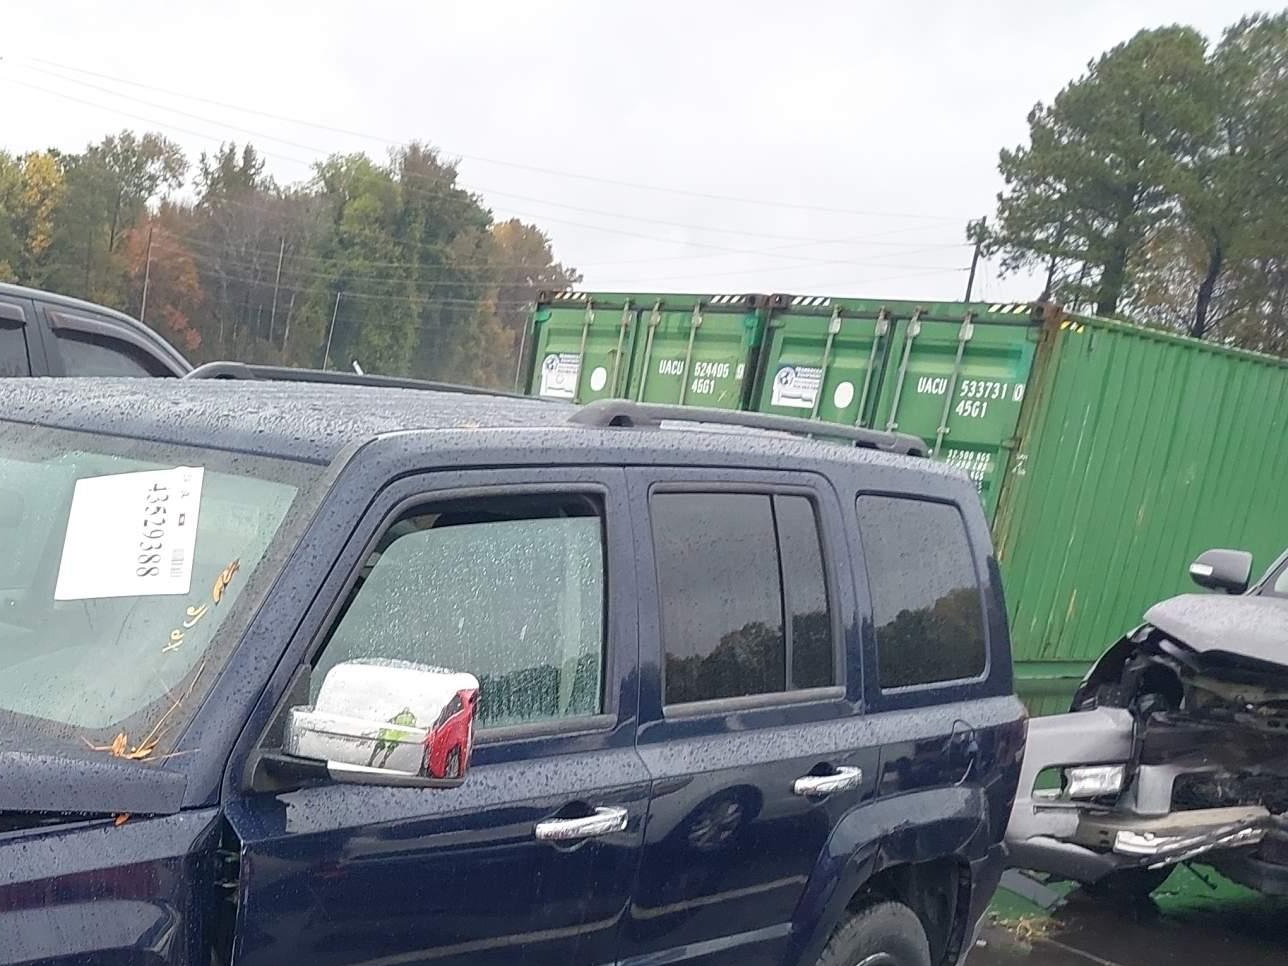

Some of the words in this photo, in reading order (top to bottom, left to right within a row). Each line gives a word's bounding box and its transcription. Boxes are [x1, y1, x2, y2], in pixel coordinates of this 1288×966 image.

[658, 359, 685, 376] UACU
[917, 376, 947, 395] UACU
[959, 380, 1008, 400] 533731
[955, 400, 988, 419] 45G1
[135, 482, 169, 578] 43529388
